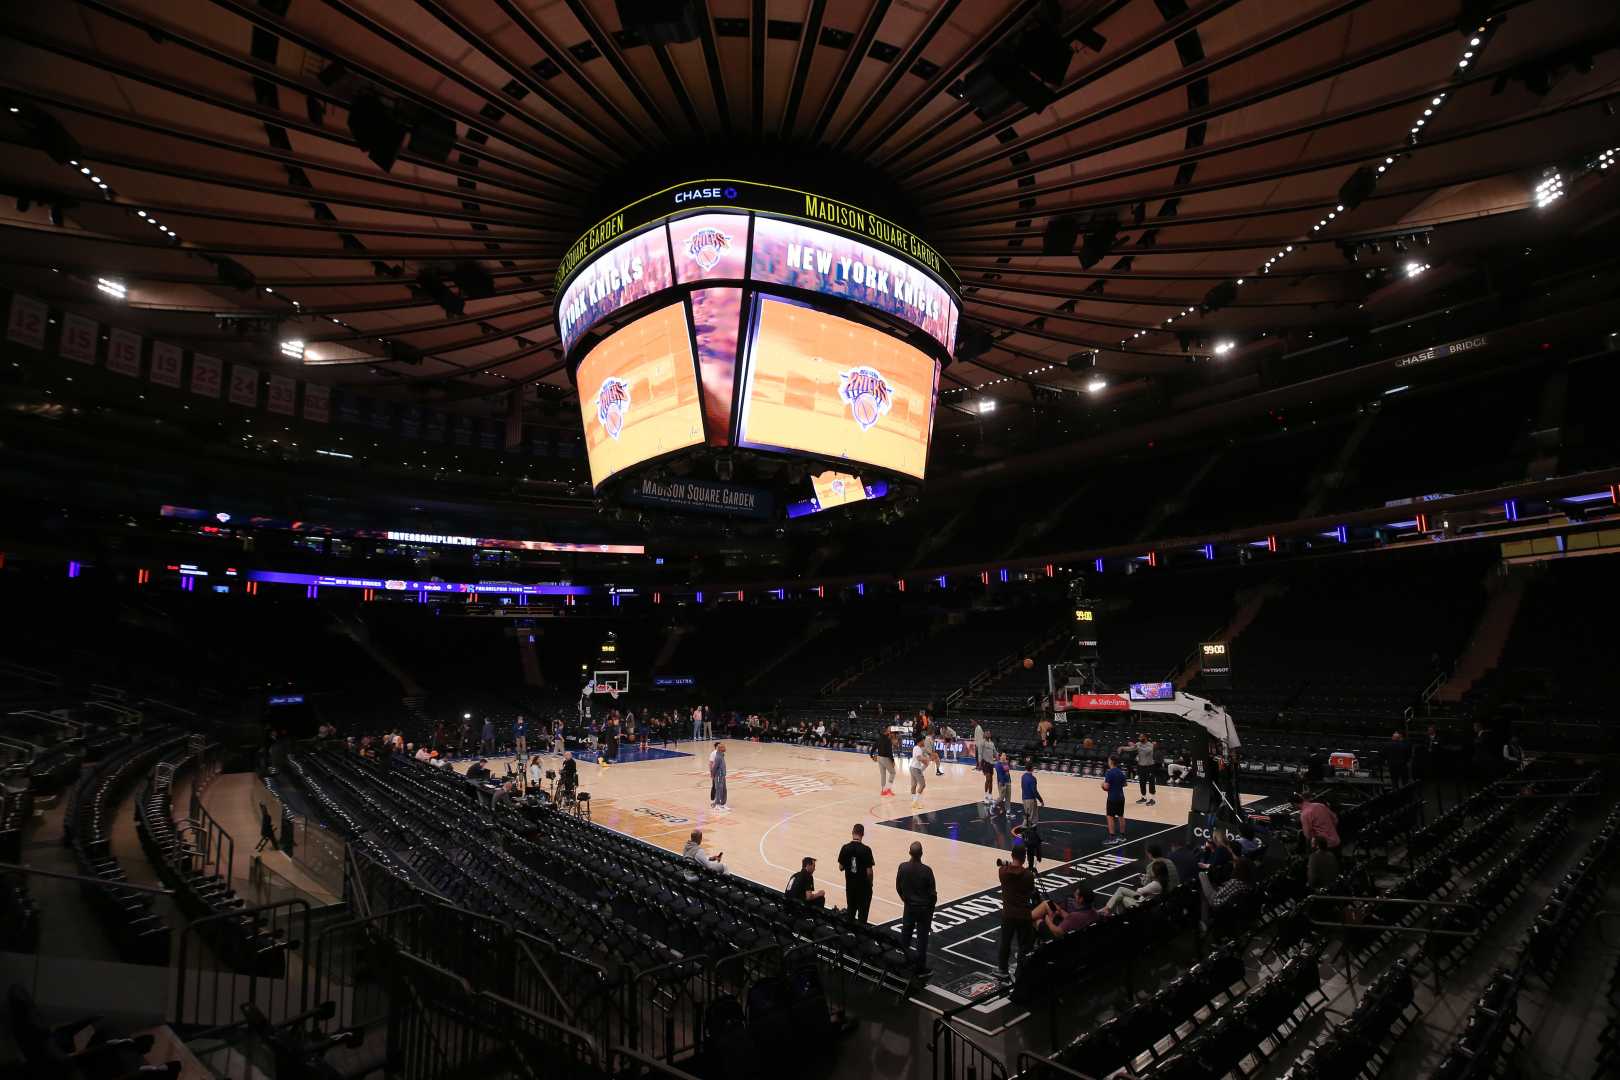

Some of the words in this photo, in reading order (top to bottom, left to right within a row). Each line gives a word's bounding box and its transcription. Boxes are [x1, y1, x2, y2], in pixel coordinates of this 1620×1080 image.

[675, 188, 721, 203] CHASE
[589, 214, 624, 250] GARDEN
[805, 195, 865, 231] MADISON
[868, 215, 908, 250] SQUARE
[910, 236, 940, 272] GARDEN
[589, 257, 643, 306] KNICKS
[786, 244, 833, 274] NEW
[839, 256, 890, 293] YORK
[894, 277, 939, 320] KNICKS
[68, 327, 90, 349] 15
[115, 342, 134, 361] 15
[1394, 350, 1436, 367] CHASE
[196, 366, 217, 385] 22
[234, 377, 254, 394] 24
[642, 480, 685, 499] MADISON
[687, 484, 721, 503] SQUARE
[723, 489, 754, 508] GARDEN
[1076, 610, 1093, 621] 99:00
[1203, 644, 1225, 655] 99:00
